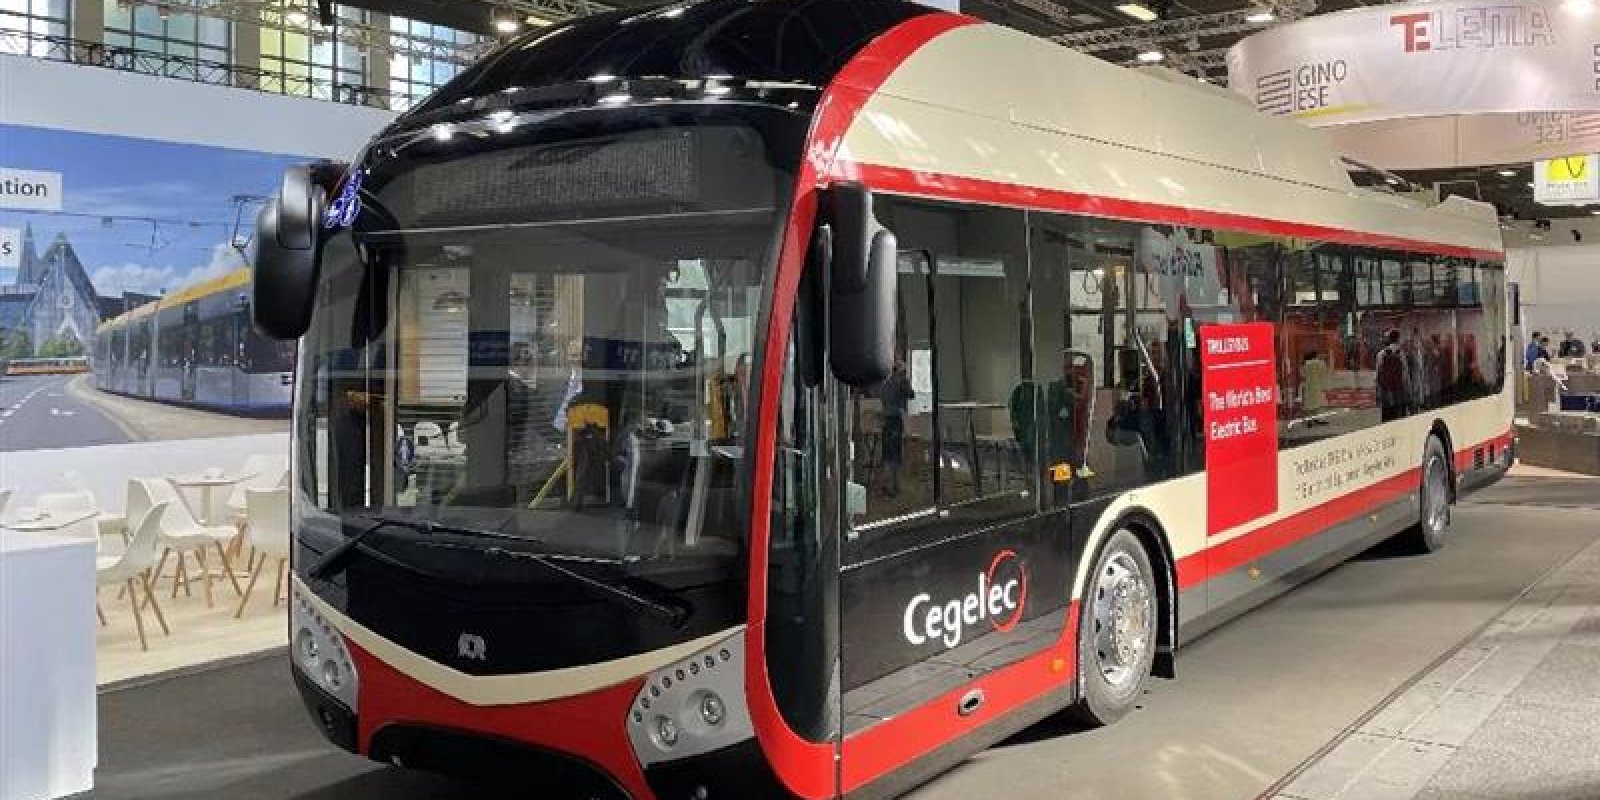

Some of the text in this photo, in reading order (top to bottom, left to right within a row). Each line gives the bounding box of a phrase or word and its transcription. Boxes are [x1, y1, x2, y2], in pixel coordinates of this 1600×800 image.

[1298, 60, 1346, 86] GINO
[1298, 85, 1328, 110] ESE
[0, 177, 47, 196] tion
[904, 572, 1018, 648] Cegelec
